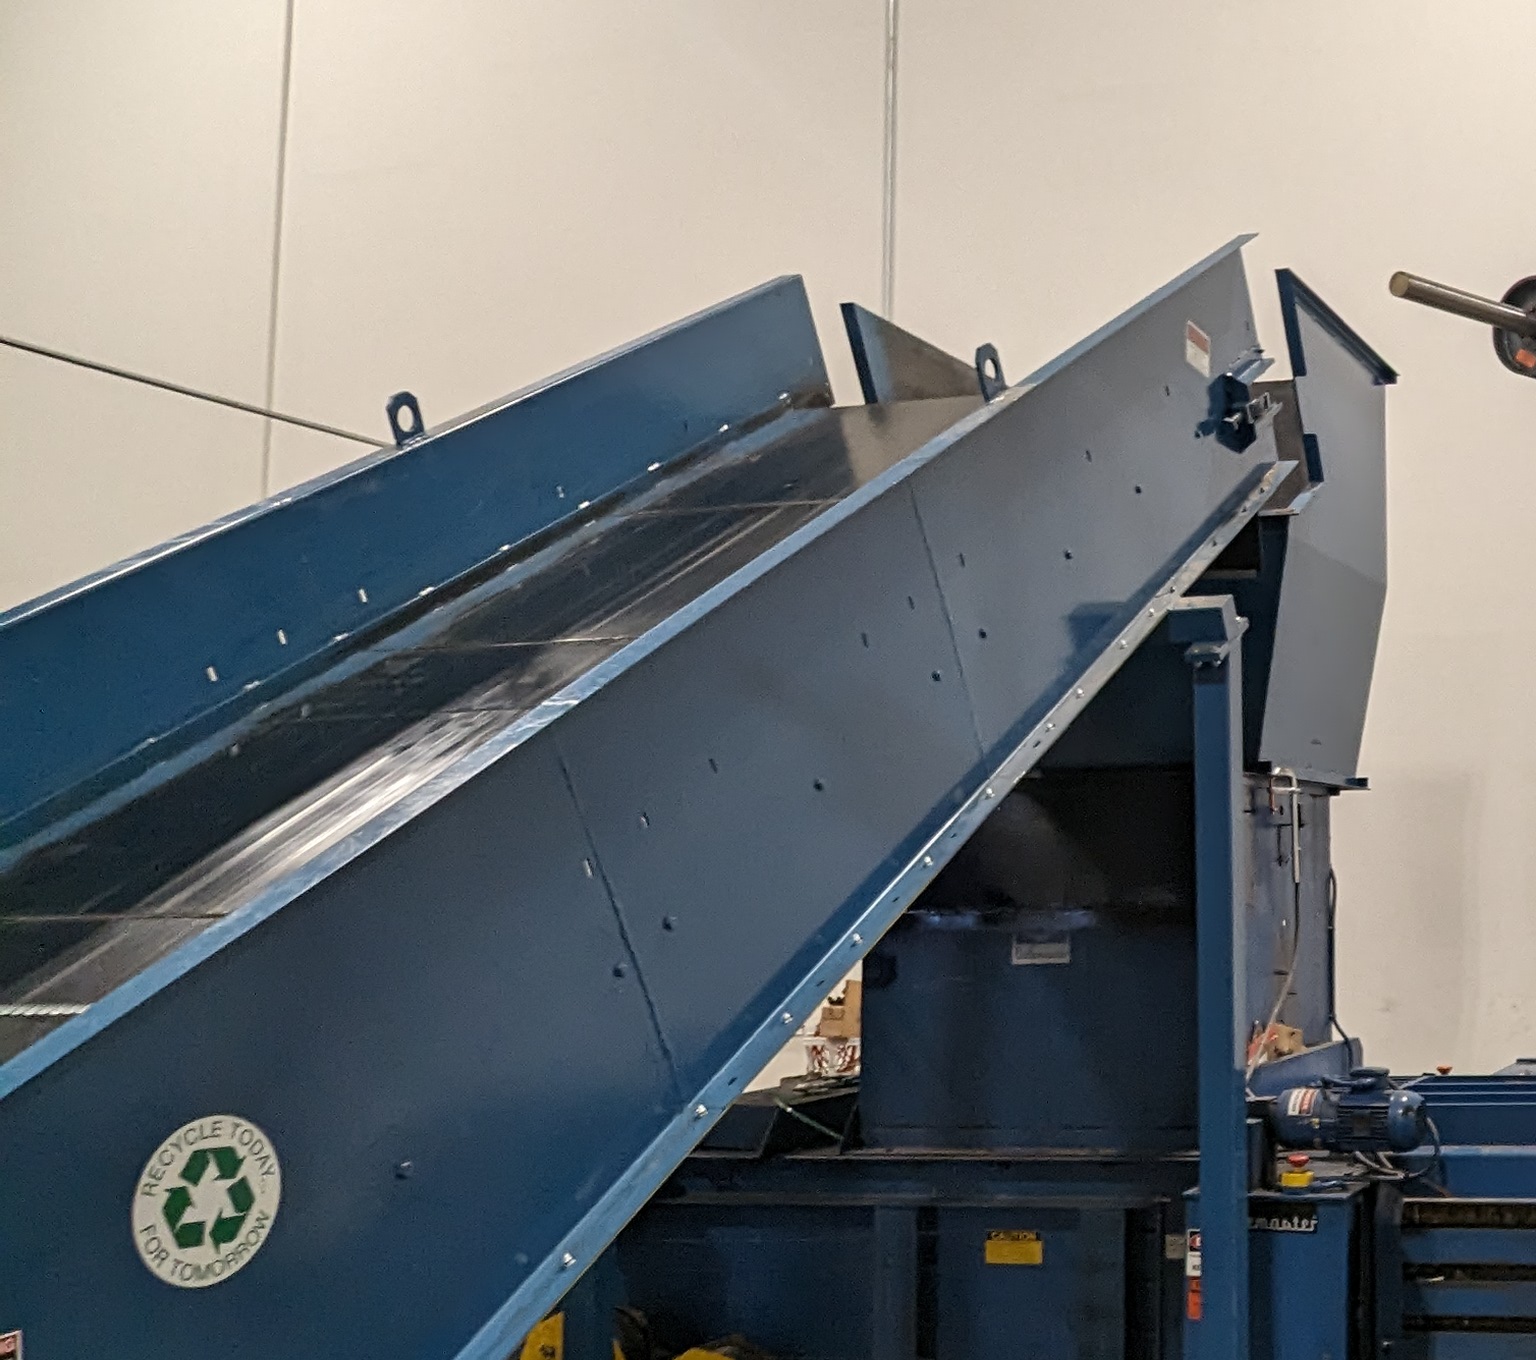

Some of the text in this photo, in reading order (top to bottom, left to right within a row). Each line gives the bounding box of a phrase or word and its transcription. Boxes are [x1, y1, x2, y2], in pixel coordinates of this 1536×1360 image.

[142, 1120, 222, 1196] RECYCLE
[141, 1211, 269, 1281] FOR TOMORROW
